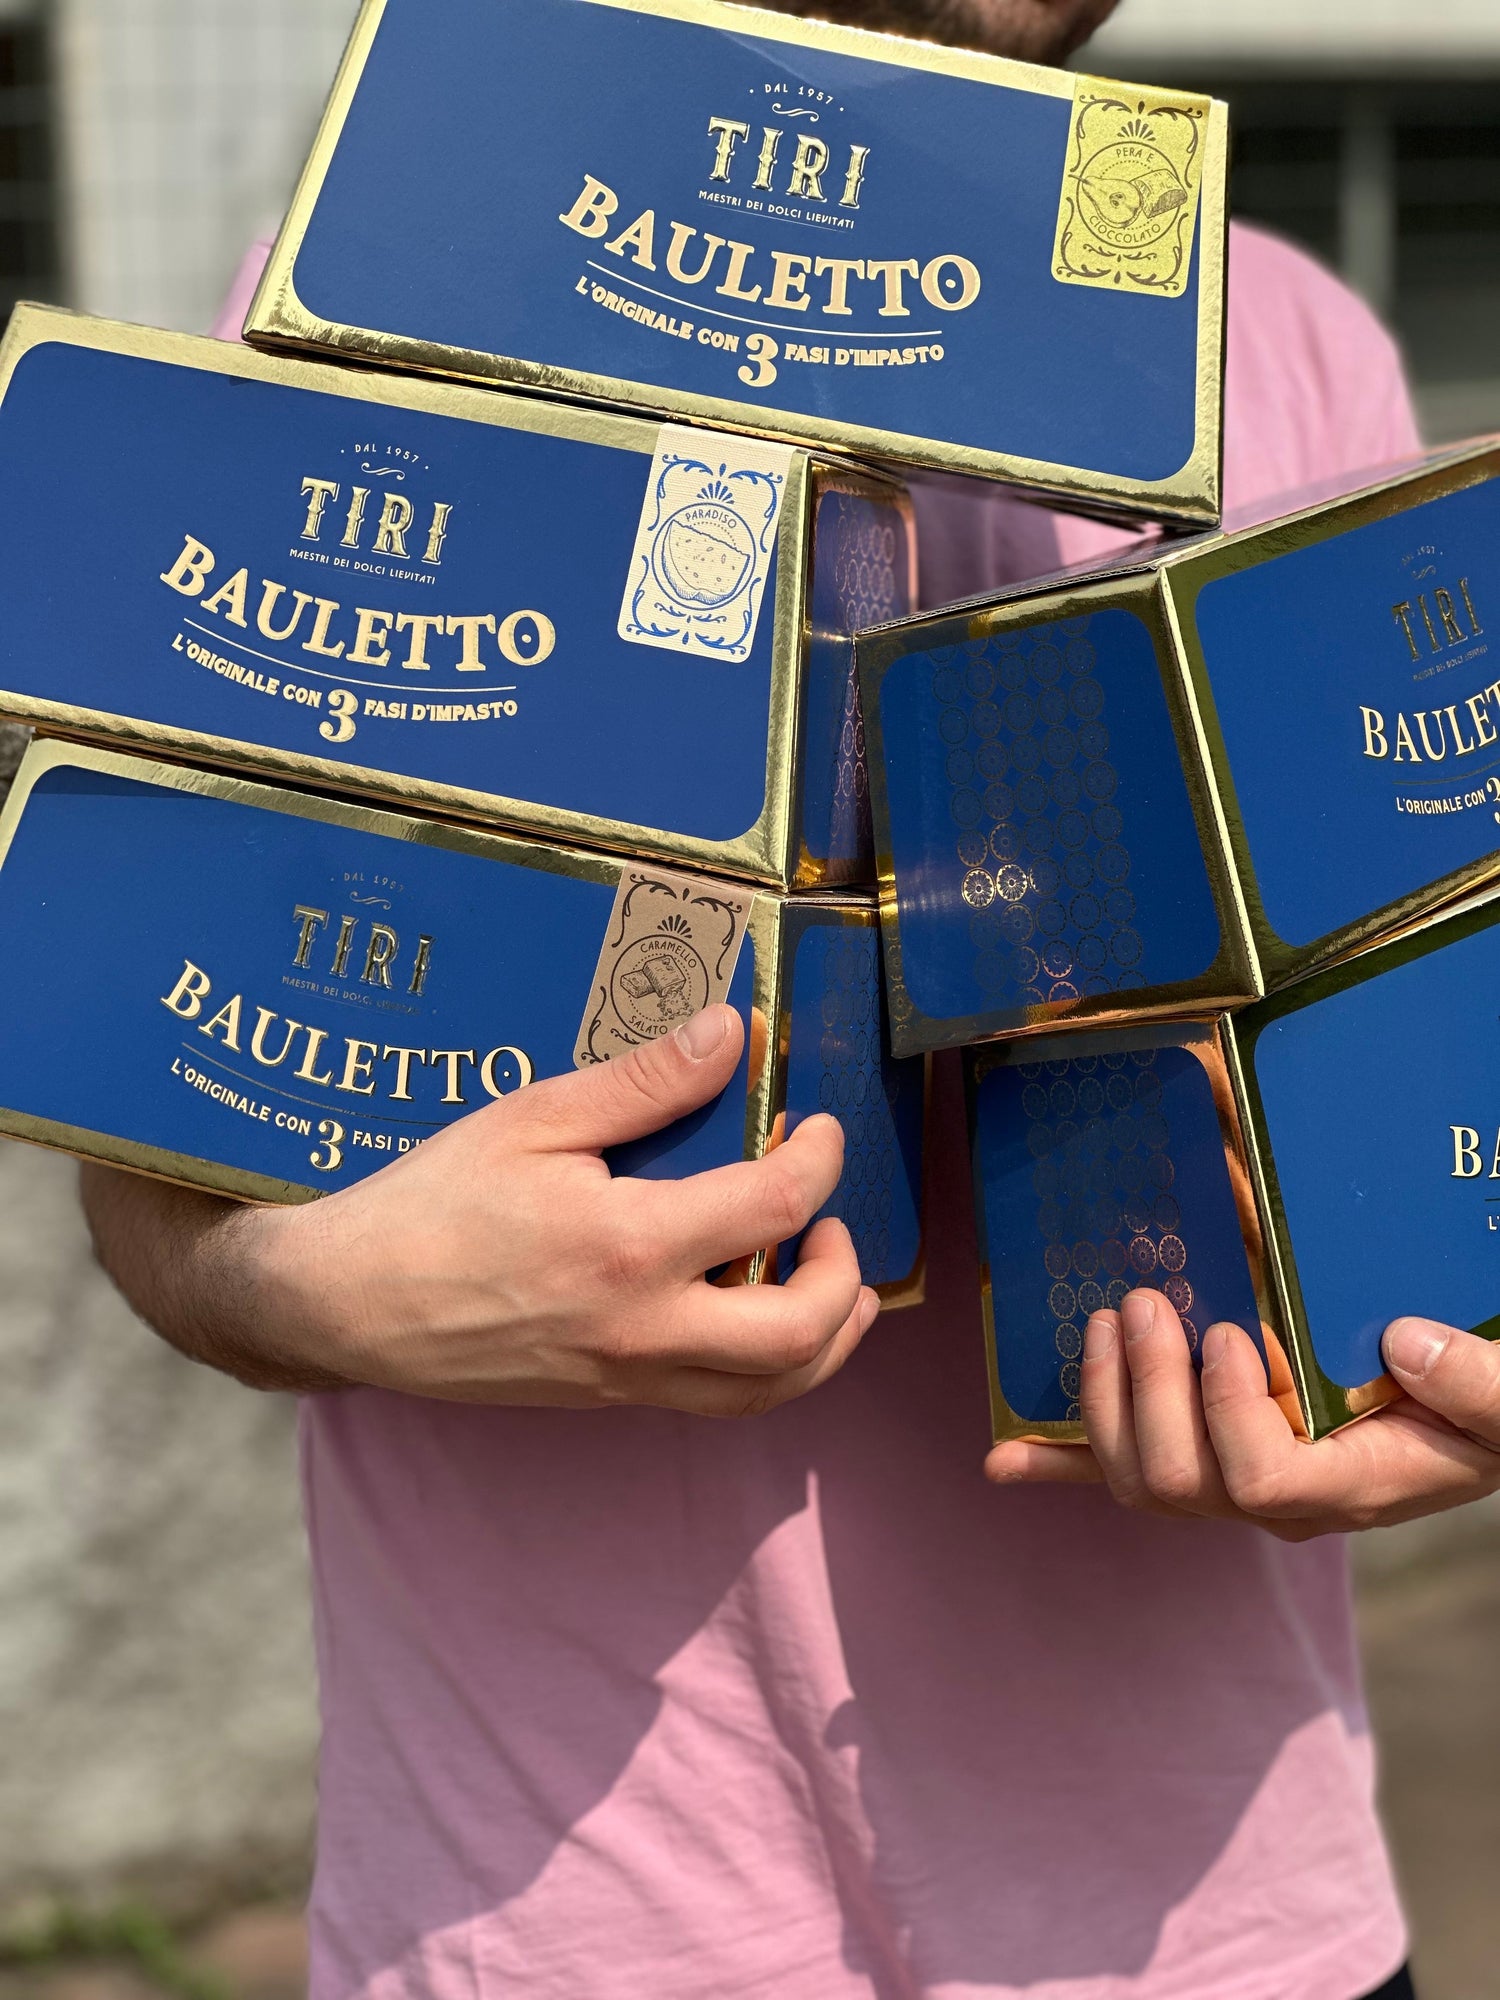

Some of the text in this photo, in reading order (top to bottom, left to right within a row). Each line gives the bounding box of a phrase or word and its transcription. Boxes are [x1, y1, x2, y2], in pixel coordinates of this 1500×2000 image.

[764, 83, 834, 105] DAL 1957
[706, 115, 871, 210] TIRI
[1115, 147, 1155, 162] PERA E
[698, 190, 855, 229] MAESTRI DEI DOLCI LIEVITATI
[558, 173, 981, 317] BAULETTO
[1089, 215, 1161, 243] CIOCCOLATO
[574, 275, 945, 388] L'ORIGINALE CON 3 FASI D'IMPASTO
[354, 443, 420, 463] DAL 1957
[300, 476, 454, 566] TIRI
[685, 509, 737, 529] PARADISO
[289, 548, 436, 585] MAESTRI DEI DOLCI LIEVITATI
[159, 533, 557, 672] BAULETTO
[1391, 576, 1484, 663] TIRI
[171, 632, 518, 743] L'ORIGINALE CON 3 FASI D'IMPASTO
[1395, 796, 1464, 815] L'ORIGINALE
[1464, 788, 1486, 808] CON
[343, 872, 365, 882] DAL
[292, 904, 436, 997] TIRI
[639, 940, 697, 969] CARAMELLO
[282, 975, 320, 993] MAESTRI
[323, 986, 339, 998] DEI
[160, 958, 536, 1105] BAULETTO
[628, 1015, 668, 1035] SALATO
[170, 1057, 272, 1122] L'ORIGINALE
[274, 1112, 312, 1137] CON
[309, 1119, 346, 1171] 3
[352, 1130, 392, 1151] FASI
